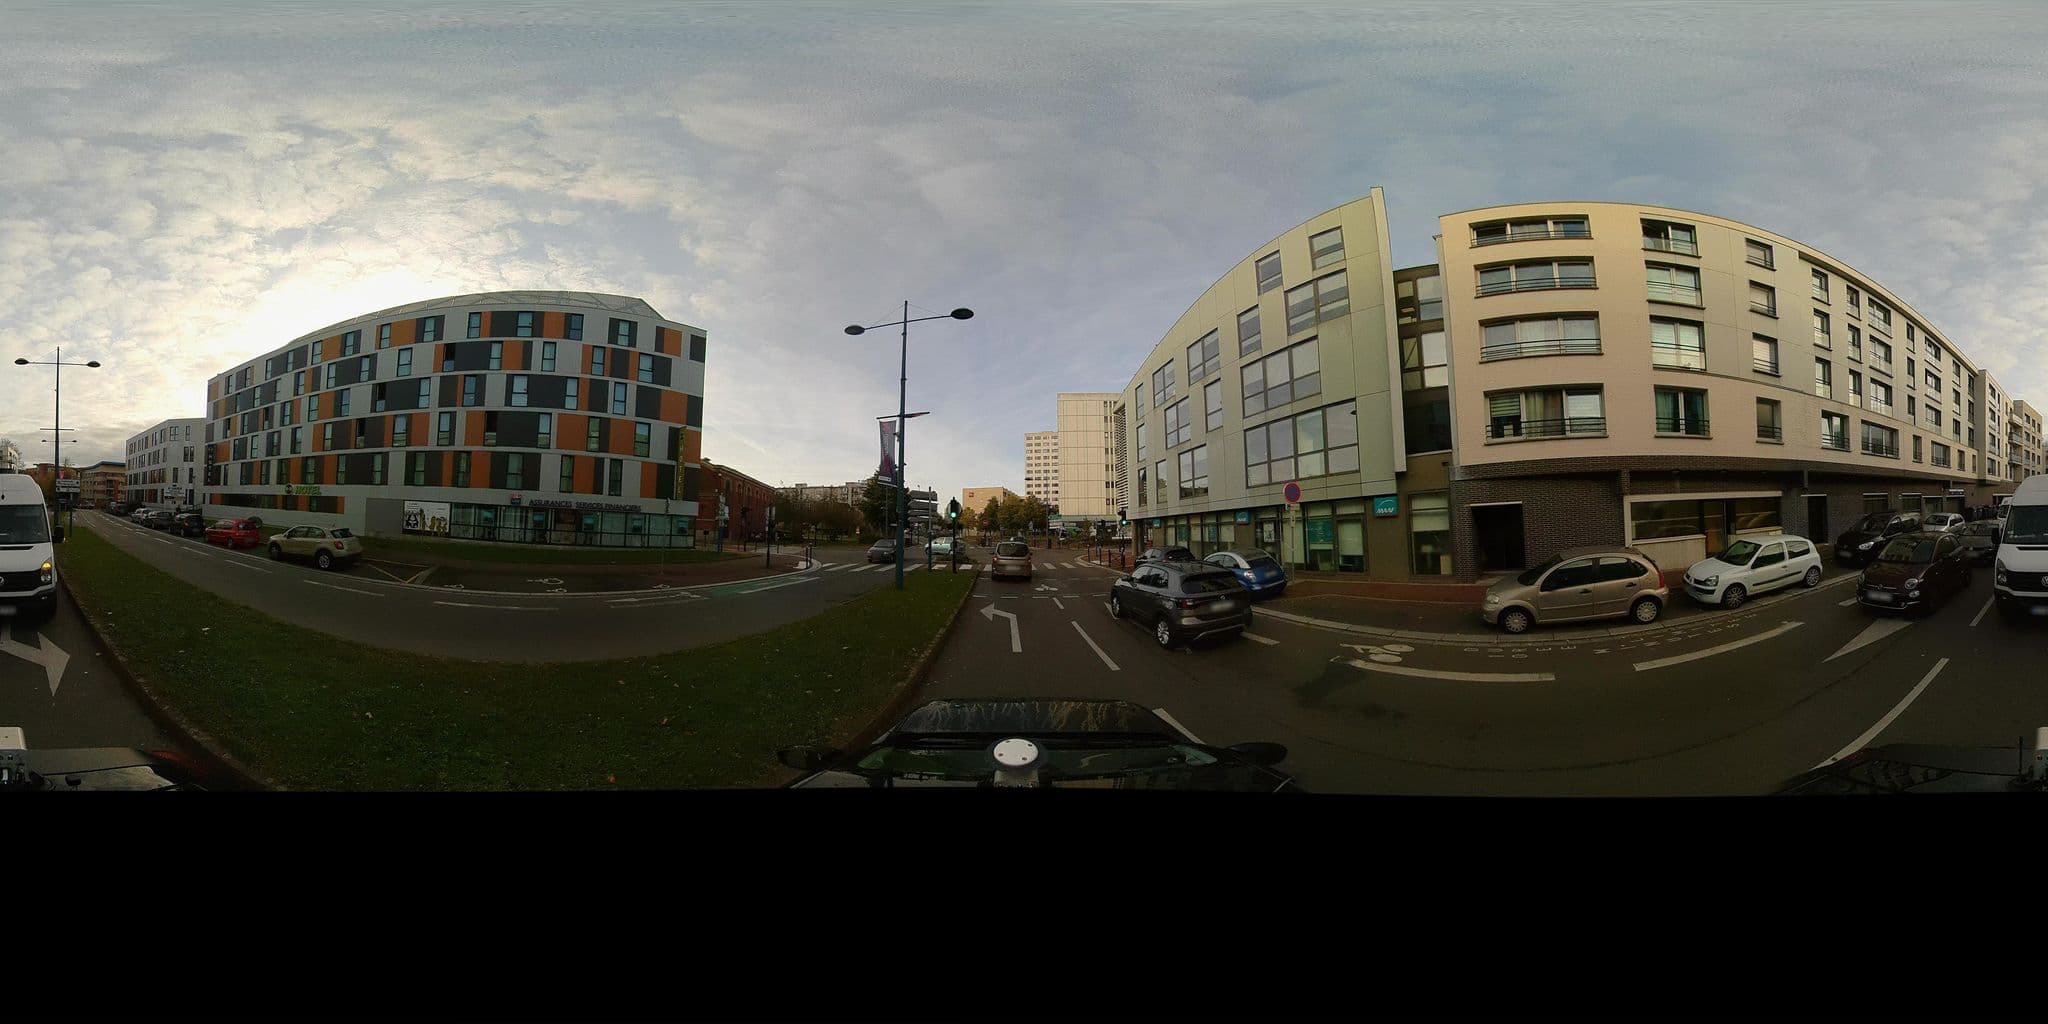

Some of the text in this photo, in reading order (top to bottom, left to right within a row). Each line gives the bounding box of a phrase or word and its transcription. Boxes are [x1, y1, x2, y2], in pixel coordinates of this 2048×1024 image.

[294, 485, 321, 495] HOTEL
[529, 499, 572, 508] ASSURANCES
[575, 501, 603, 509] SERVICES
